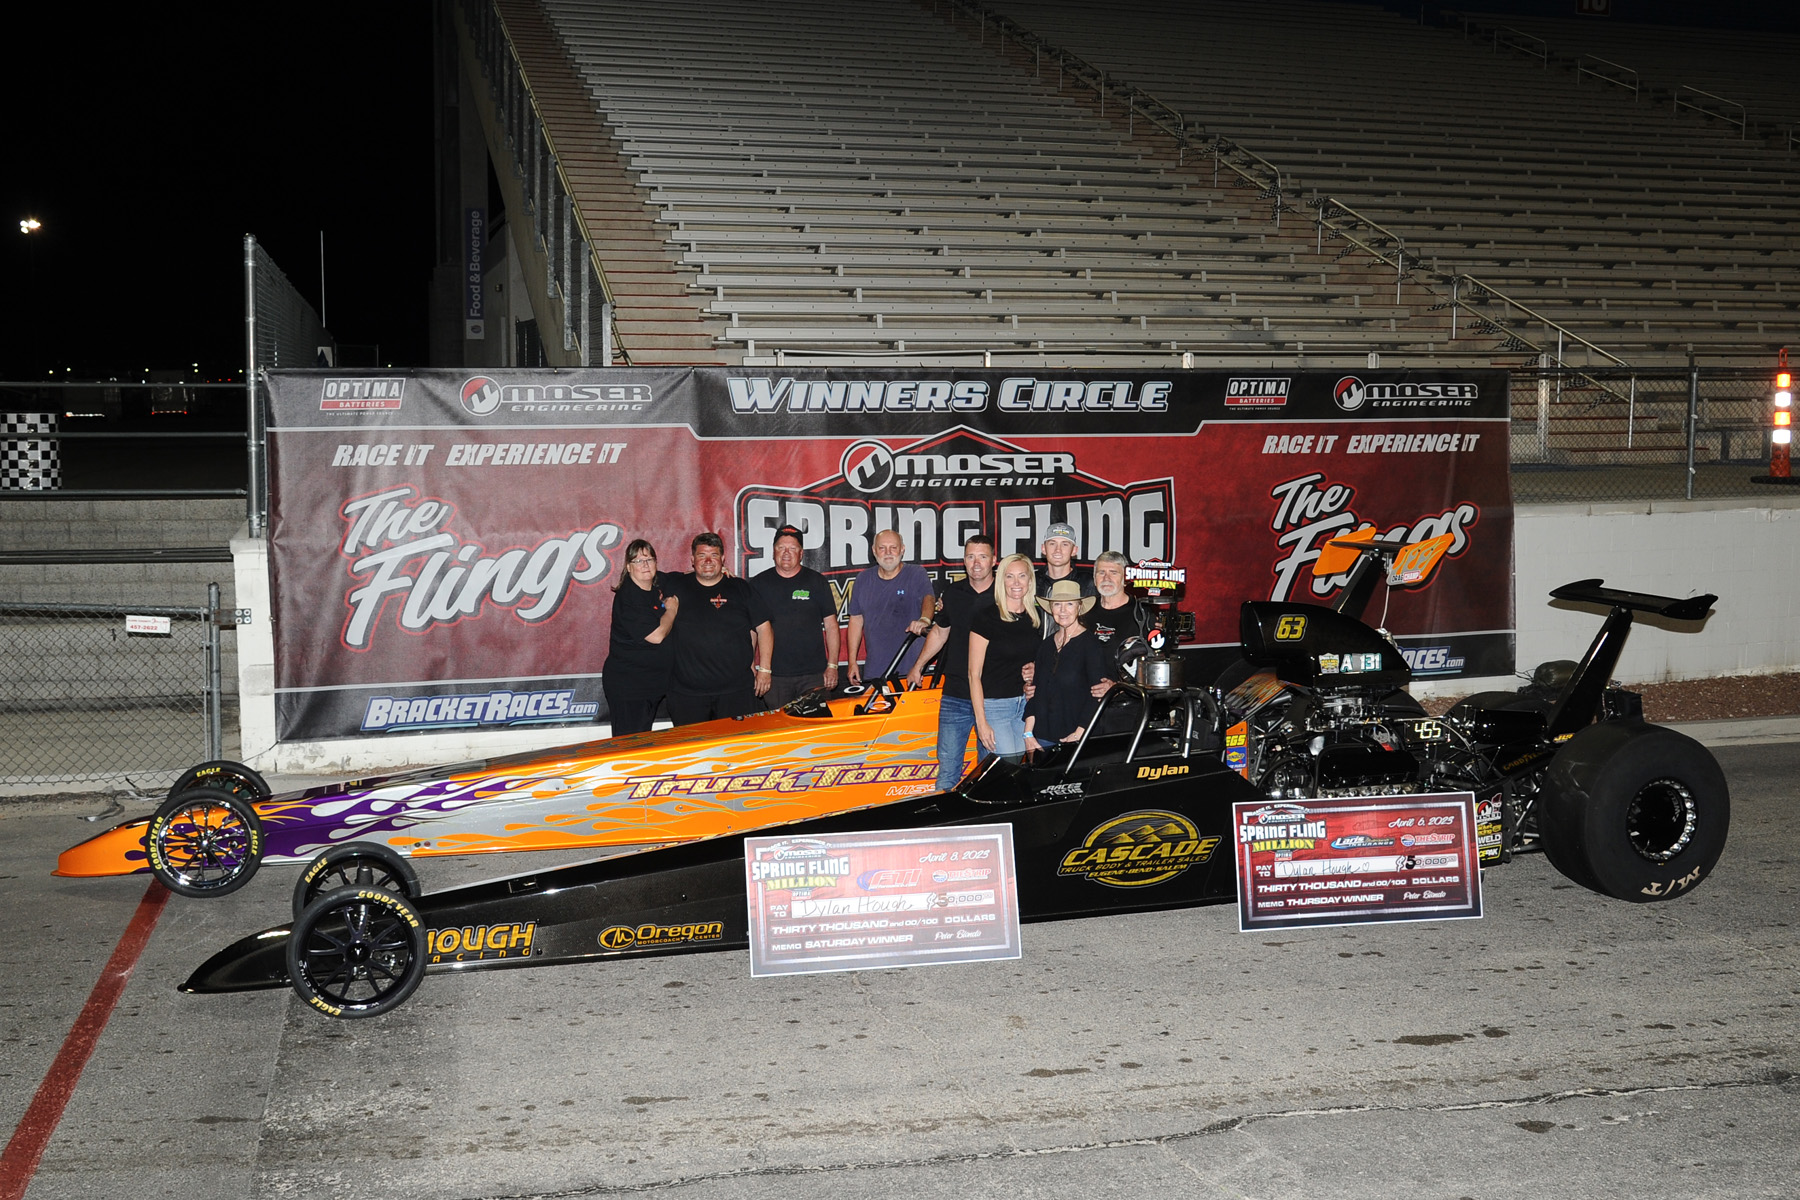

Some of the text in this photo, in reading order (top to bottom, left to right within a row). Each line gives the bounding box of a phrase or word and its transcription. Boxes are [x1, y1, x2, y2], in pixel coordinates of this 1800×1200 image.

[470, 211, 482, 317] Food & Beverage
[326, 382, 400, 398] OPTIMA
[501, 384, 653, 403] MOSER
[727, 378, 1173, 414] WINNERS CIRCLE
[1230, 381, 1286, 394] OPTIMA
[1364, 383, 1478, 399] MOSER
[511, 404, 643, 412] ENGINEERING
[1372, 400, 1472, 408] ENGINEERING
[1262, 435, 1338, 454] RACE IT
[1346, 434, 1480, 454] EXPERIENCE IT
[332, 444, 434, 467] RACE IT
[445, 443, 627, 467] EXPERIENCE IT
[894, 454, 1075, 475] MOSER
[895, 477, 1055, 488] ENGINEERING
[1272, 474, 1351, 530] The
[342, 487, 450, 555] The
[1125, 566, 1185, 582] SPRING FLING
[345, 523, 620, 647] Flings
[1133, 580, 1177, 590] MILLION
[1276, 615, 1307, 641] 63
[1340, 653, 1353, 672] A
[1360, 653, 1382, 671] 131
[1398, 648, 1464, 670] ACES.com
[1414, 721, 1442, 740] 455
[1226, 734, 1246, 747] EGS
[196, 767, 222, 778] EAGLE
[1136, 764, 1190, 780] Dylan
[624, 769, 808, 800] Truck
[1240, 820, 1327, 843] SPRING FLING
[1388, 818, 1415, 828] April
[150, 816, 164, 870] GOODYEAR
[250, 830, 258, 856] EAGLE
[1062, 838, 1220, 867] CASCADE
[1252, 839, 1316, 852] MILLION
[919, 852, 948, 864] April
[1060, 864, 1093, 874] TRUCK
[1094, 862, 1122, 870] BODY
[1136, 858, 1176, 866] TRAILER
[1178, 854, 1208, 862] SALES
[304, 857, 328, 884] EAGLE
[752, 856, 850, 881] SPRING FLING
[1256, 864, 1272, 872] PAY
[766, 876, 838, 891] MILLION
[1257, 884, 1298, 893] THIRTY
[1298, 880, 1362, 890] THOUSAND
[1412, 876, 1460, 884] DOLLARS
[358, 890, 420, 928] GOODYEAR
[770, 904, 788, 912] PAY
[801, 894, 913, 918] Dylan Hough
[1286, 896, 1342, 906] THURSDAY
[1342, 894, 1384, 902] WINNER
[637, 922, 722, 940] Oregon
[772, 924, 817, 934] THIRTY
[818, 920, 888, 932] THOUSAND
[904, 918, 938, 926] 00/100
[944, 914, 996, 924] DOLLARS
[772, 934, 914, 952] MEMO SATURDAY WINNER
[432, 948, 530, 963] ACING
[310, 996, 342, 1016] EAGLE
